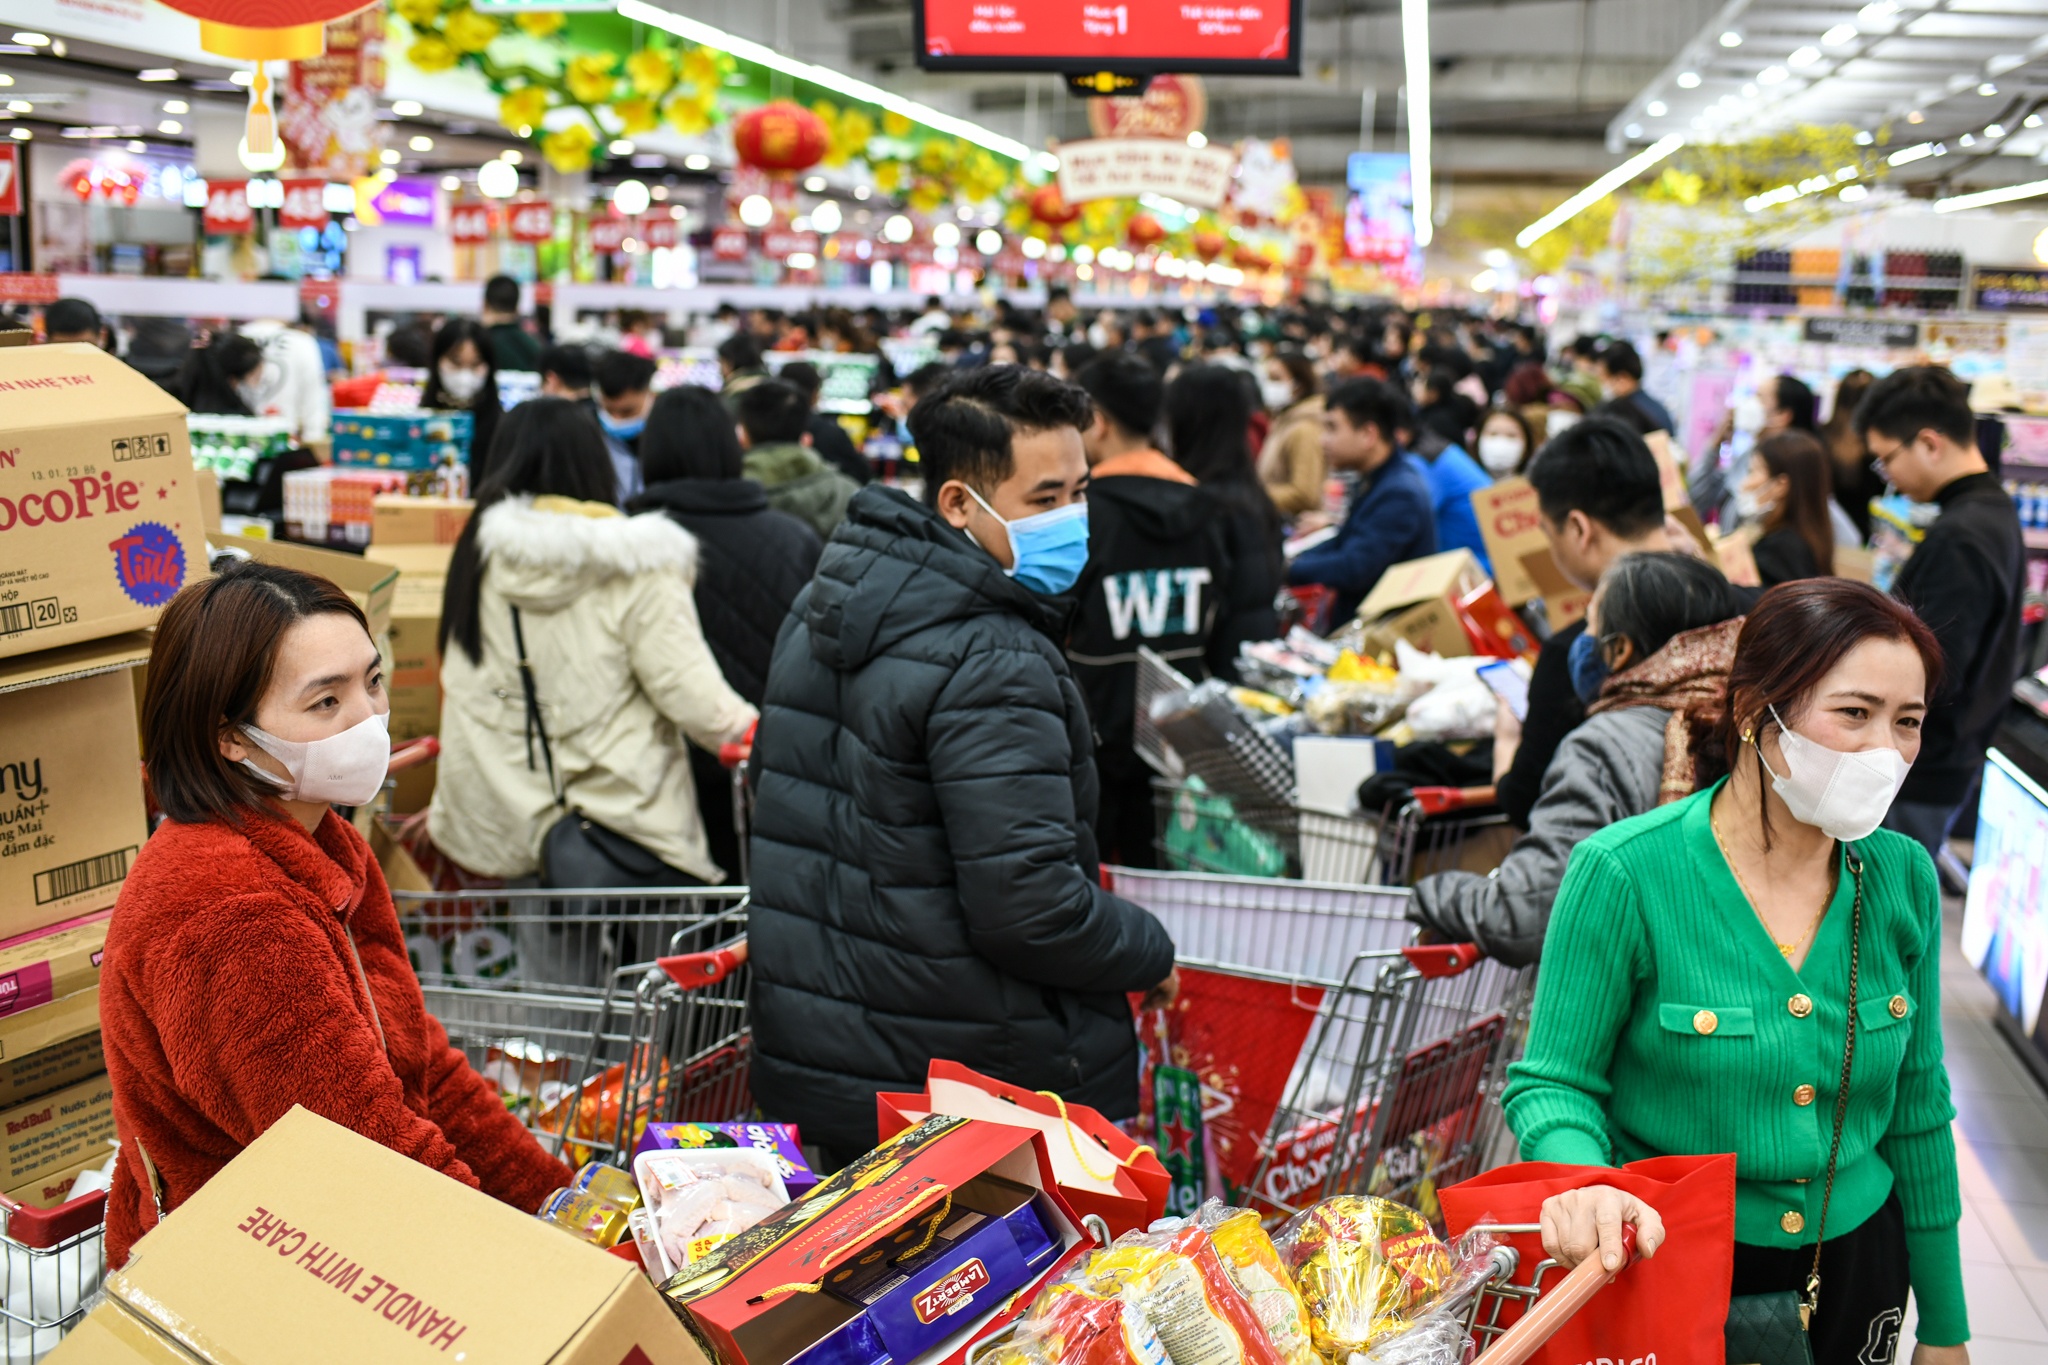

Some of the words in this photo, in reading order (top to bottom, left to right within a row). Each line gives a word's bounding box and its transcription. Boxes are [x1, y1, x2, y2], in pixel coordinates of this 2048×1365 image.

[1112, 5, 1127, 35] 1
[205, 191, 249, 221] 46
[284, 188, 325, 220] 45
[57, 374, 95, 386] TAY
[108, 536, 180, 588] Tình
[37, 603, 56, 622] 20
[1103, 566, 1213, 640] WT
[18, 819, 43, 837] Mai
[2, 842, 30, 857] đậm
[867, 1175, 909, 1203] Biscuit
[237, 1206, 308, 1257] CARE
[793, 1204, 865, 1252] Assortment
[295, 1241, 365, 1294] WITH
[351, 1274, 468, 1352] HANDLE
